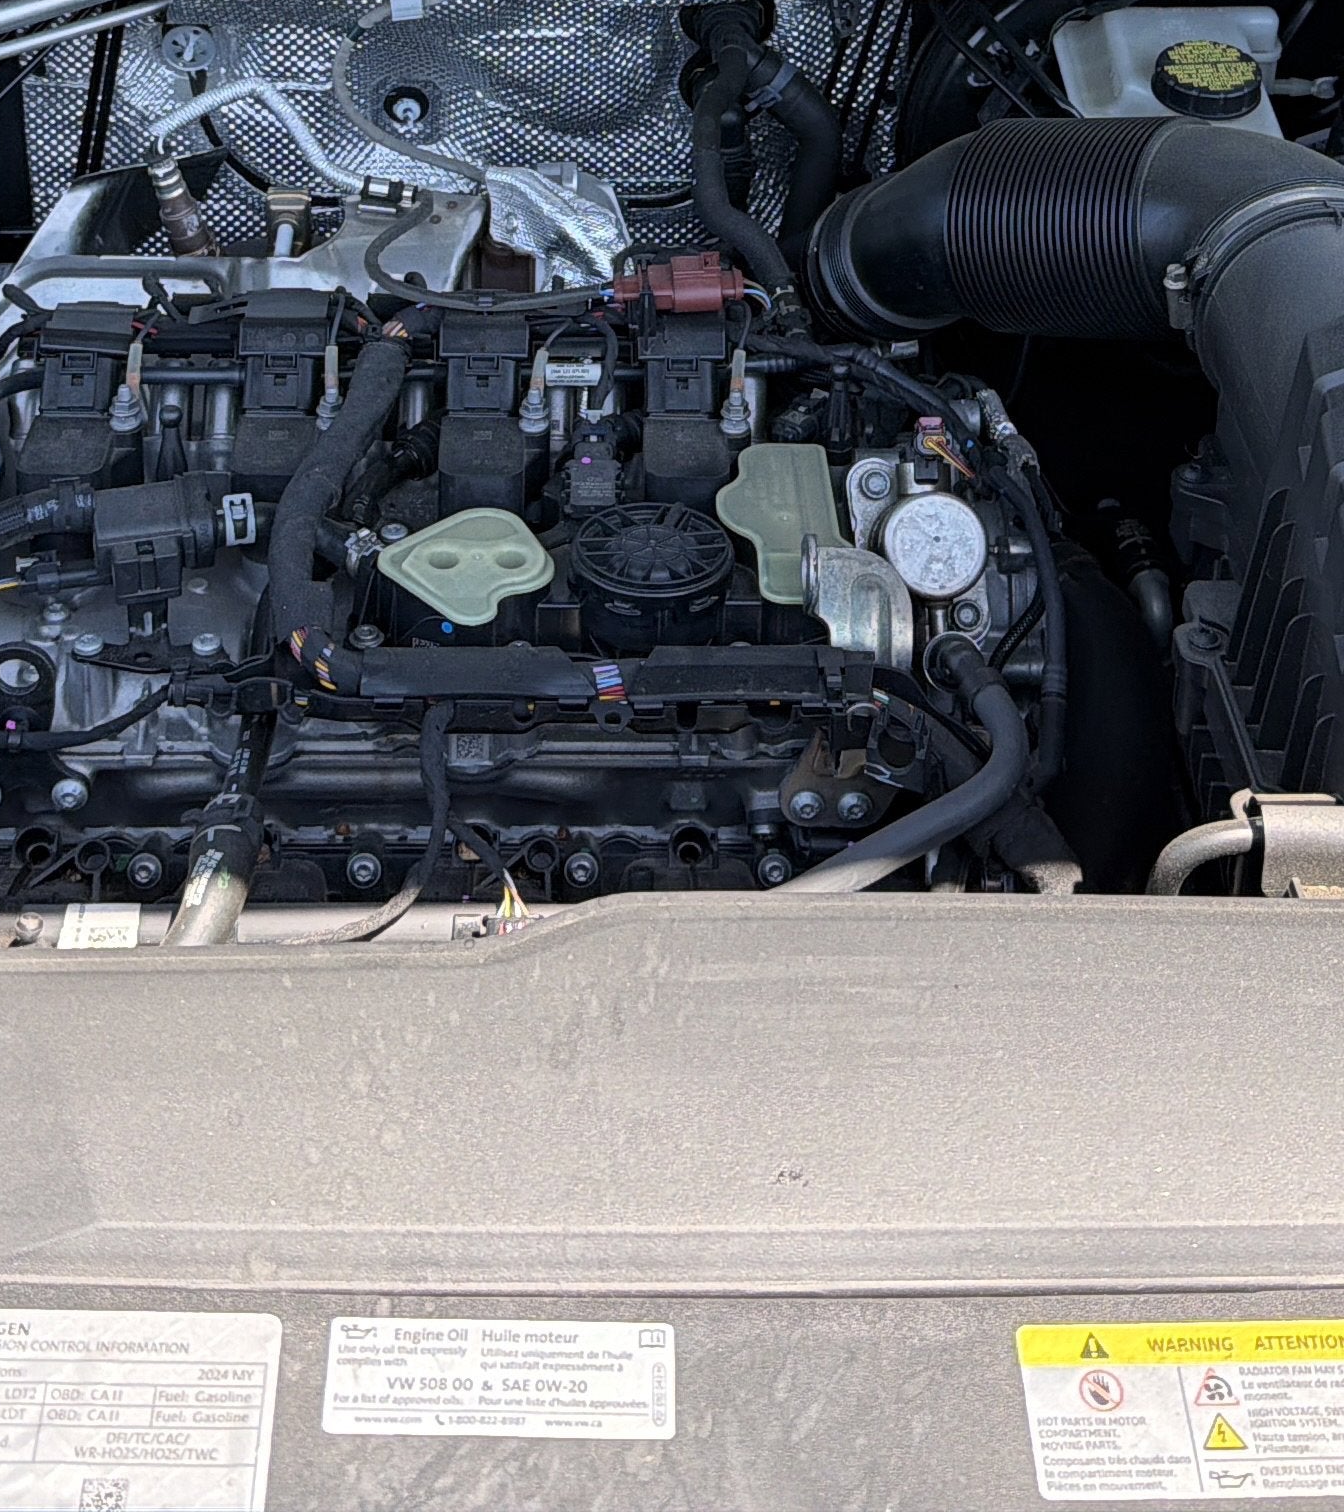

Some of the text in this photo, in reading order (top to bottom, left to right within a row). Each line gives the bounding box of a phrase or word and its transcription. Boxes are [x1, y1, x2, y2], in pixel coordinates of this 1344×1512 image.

[394, 1327, 468, 1345] Engine Oil
[481, 1329, 579, 1345] Huile moteur
[30, 1340, 92, 1354] CONTROL
[96, 1340, 190, 1355] INFORMATION
[1146, 1337, 1234, 1352] WARNING
[359, 1346, 381, 1356] only
[420, 1347, 467, 1357] expressly
[480, 1360, 497, 1371] qui
[1239, 1366, 1289, 1376] RADIATOR
[197, 1369, 255, 1381] 2024 MY
[386, 1377, 588, 1394] VW 508 00 & SAE 0W-20
[50, 1389, 84, 1402] OBD:
[158, 1391, 253, 1404] Fuel: Gasoline
[46, 1409, 81, 1422] OBD:
[192, 1411, 250, 1424] Gasoline
[1037, 1417, 1059, 1427] HOT
[1061, 1417, 1093, 1427] PARTS
[1108, 1416, 1146, 1426] MOTOR
